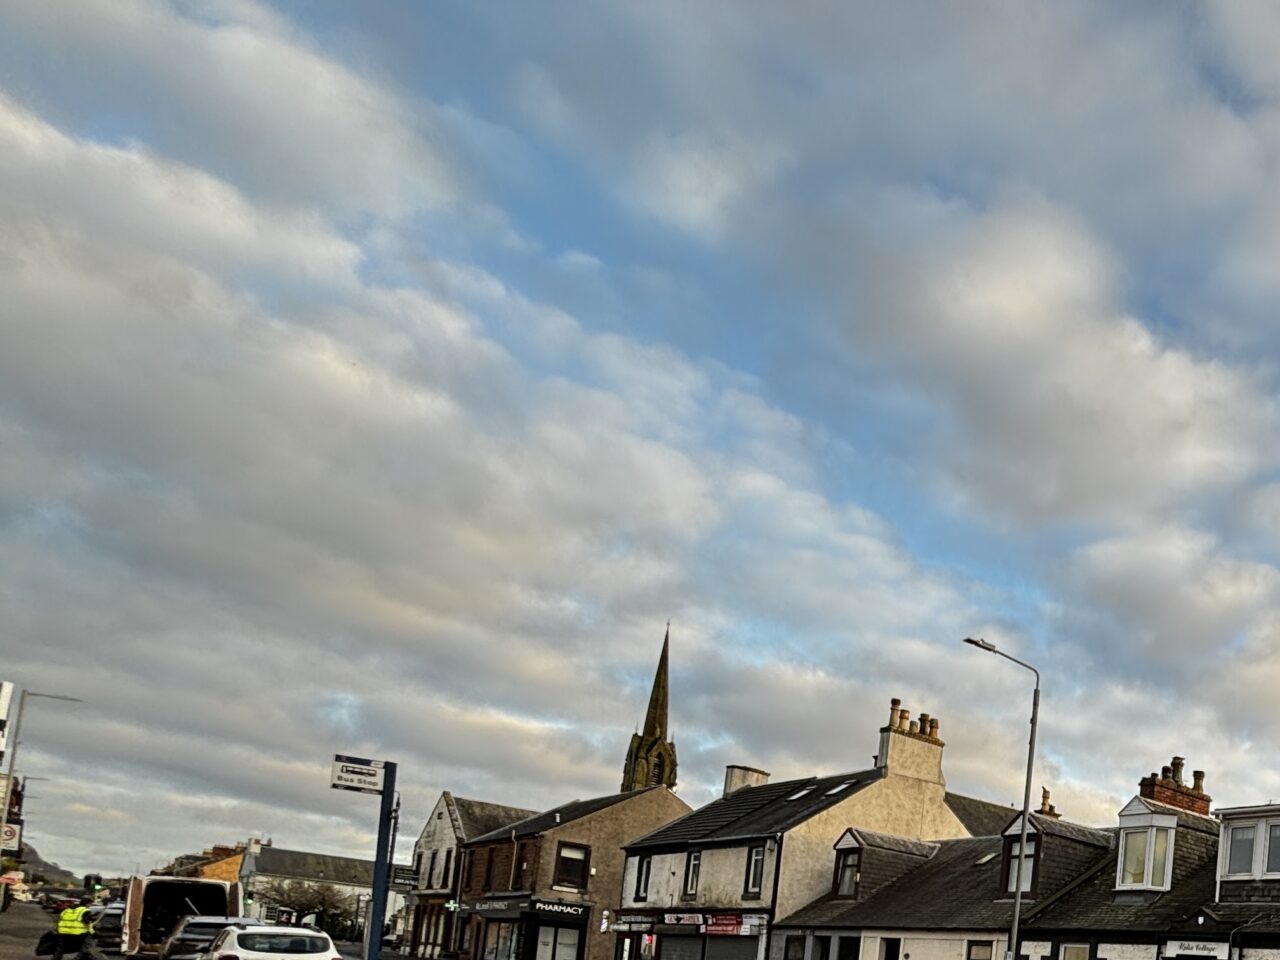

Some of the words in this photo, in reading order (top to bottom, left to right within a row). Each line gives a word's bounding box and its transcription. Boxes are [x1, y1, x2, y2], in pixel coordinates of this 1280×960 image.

[337, 775, 354, 783] Bus
[357, 778, 378, 787] Stop
[536, 903, 583, 914] PHARMACY
